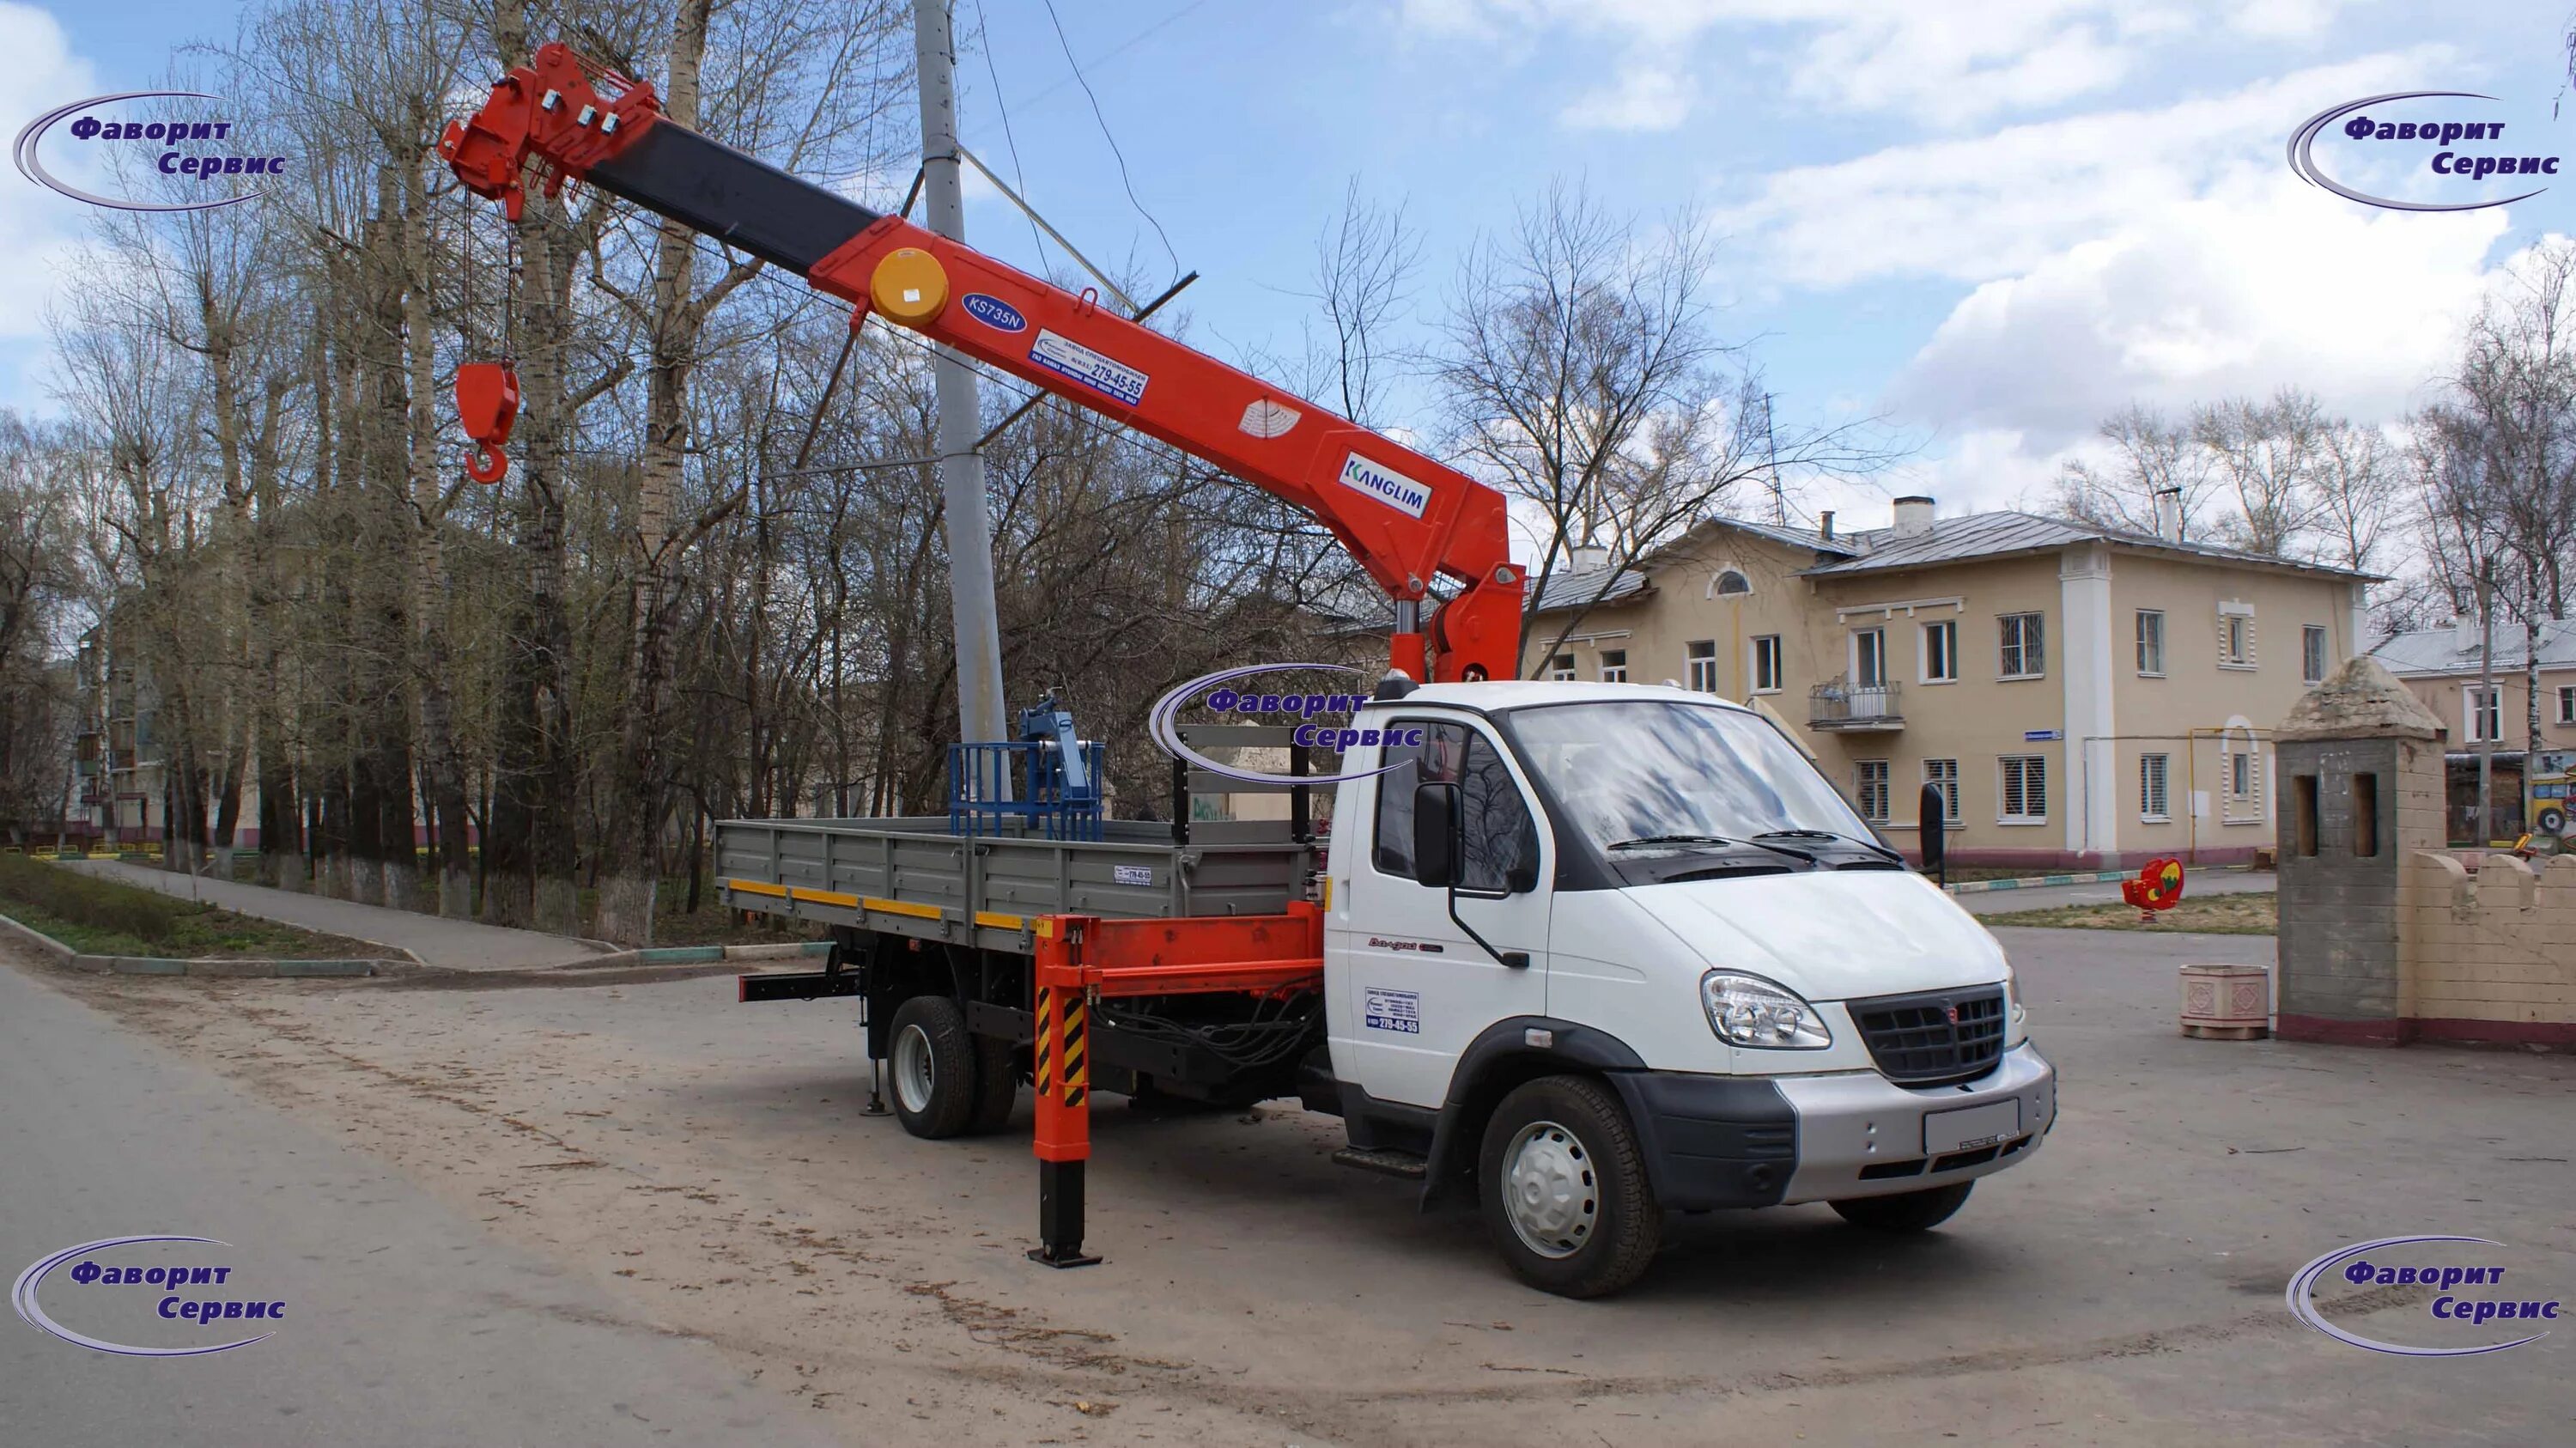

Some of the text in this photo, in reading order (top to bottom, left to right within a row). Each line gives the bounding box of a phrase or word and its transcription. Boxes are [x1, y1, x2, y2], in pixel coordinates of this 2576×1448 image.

[969, 297, 1020, 327] KS735N
[1031, 353, 1042, 362] ГАЗ
[1064, 341, 1084, 355] ЗАВОД
[1085, 350, 1146, 381] СПЕЦАВТОМОБИЛЕЙ
[1091, 363, 1142, 395] 279-45-55
[1345, 460, 1424, 509] KANGLIM
[1379, 1018, 1418, 1032] 279-45-55
